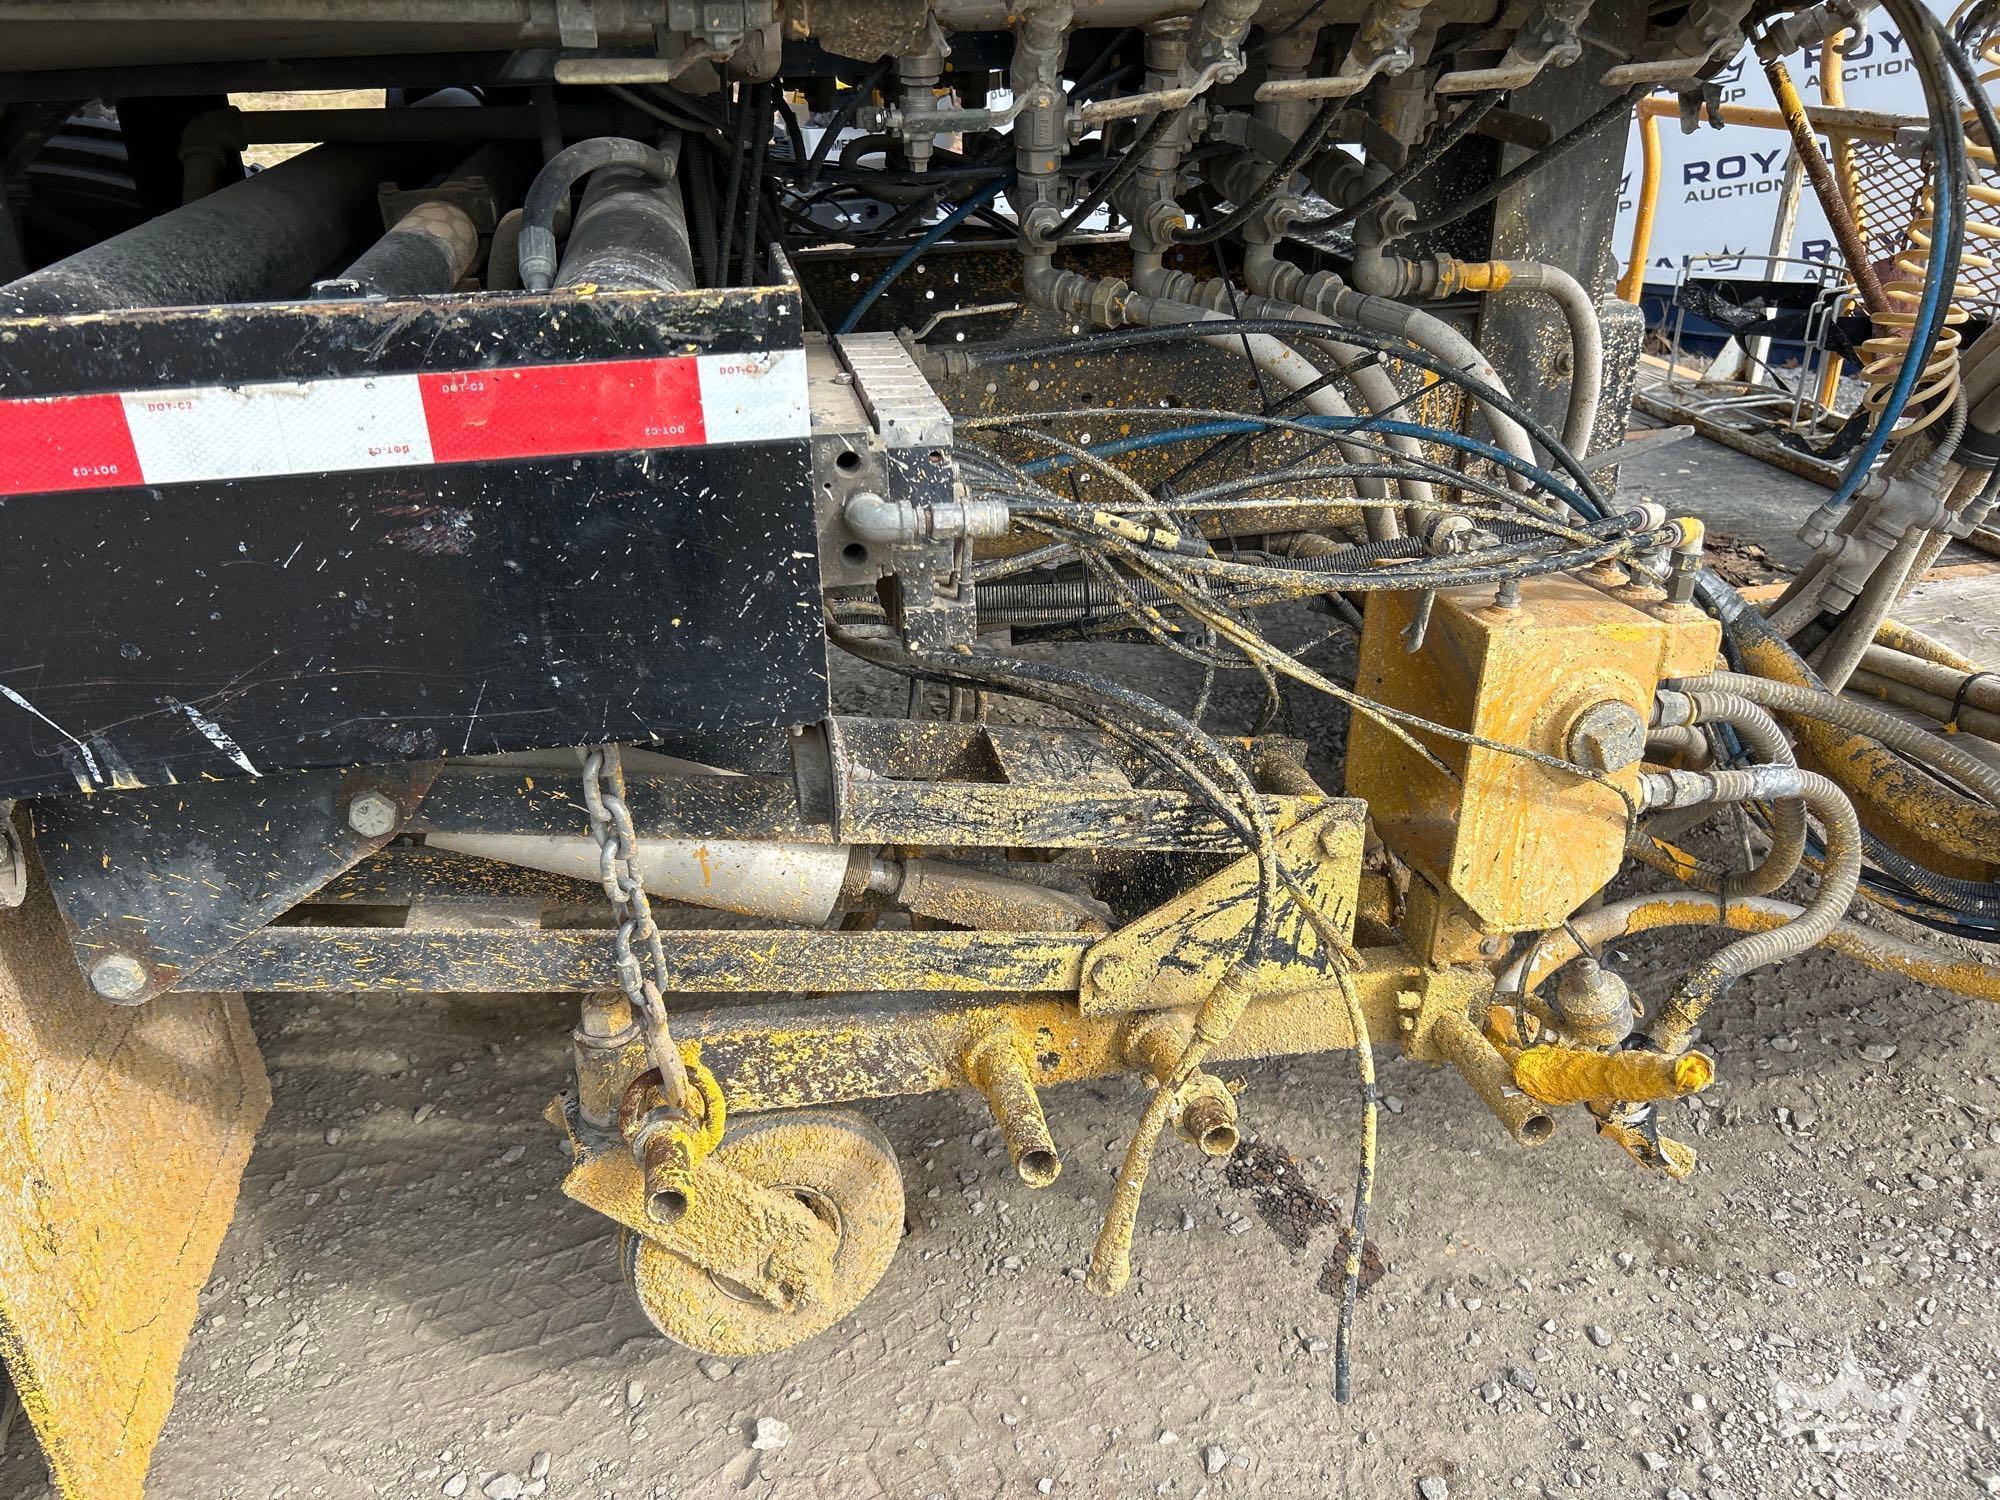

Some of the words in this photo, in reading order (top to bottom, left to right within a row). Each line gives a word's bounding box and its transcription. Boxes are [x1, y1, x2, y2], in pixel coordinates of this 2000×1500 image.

[1804, 57, 1915, 88] ACTION
[1683, 142, 1834, 186] ROYL
[719, 365, 759, 375] DOT-C2
[442, 382, 485, 394] DOT-C2
[148, 401, 193, 412] DOT-C2
[645, 425, 685, 436] DOT-C2
[73, 464, 118, 477] DOT-C2
